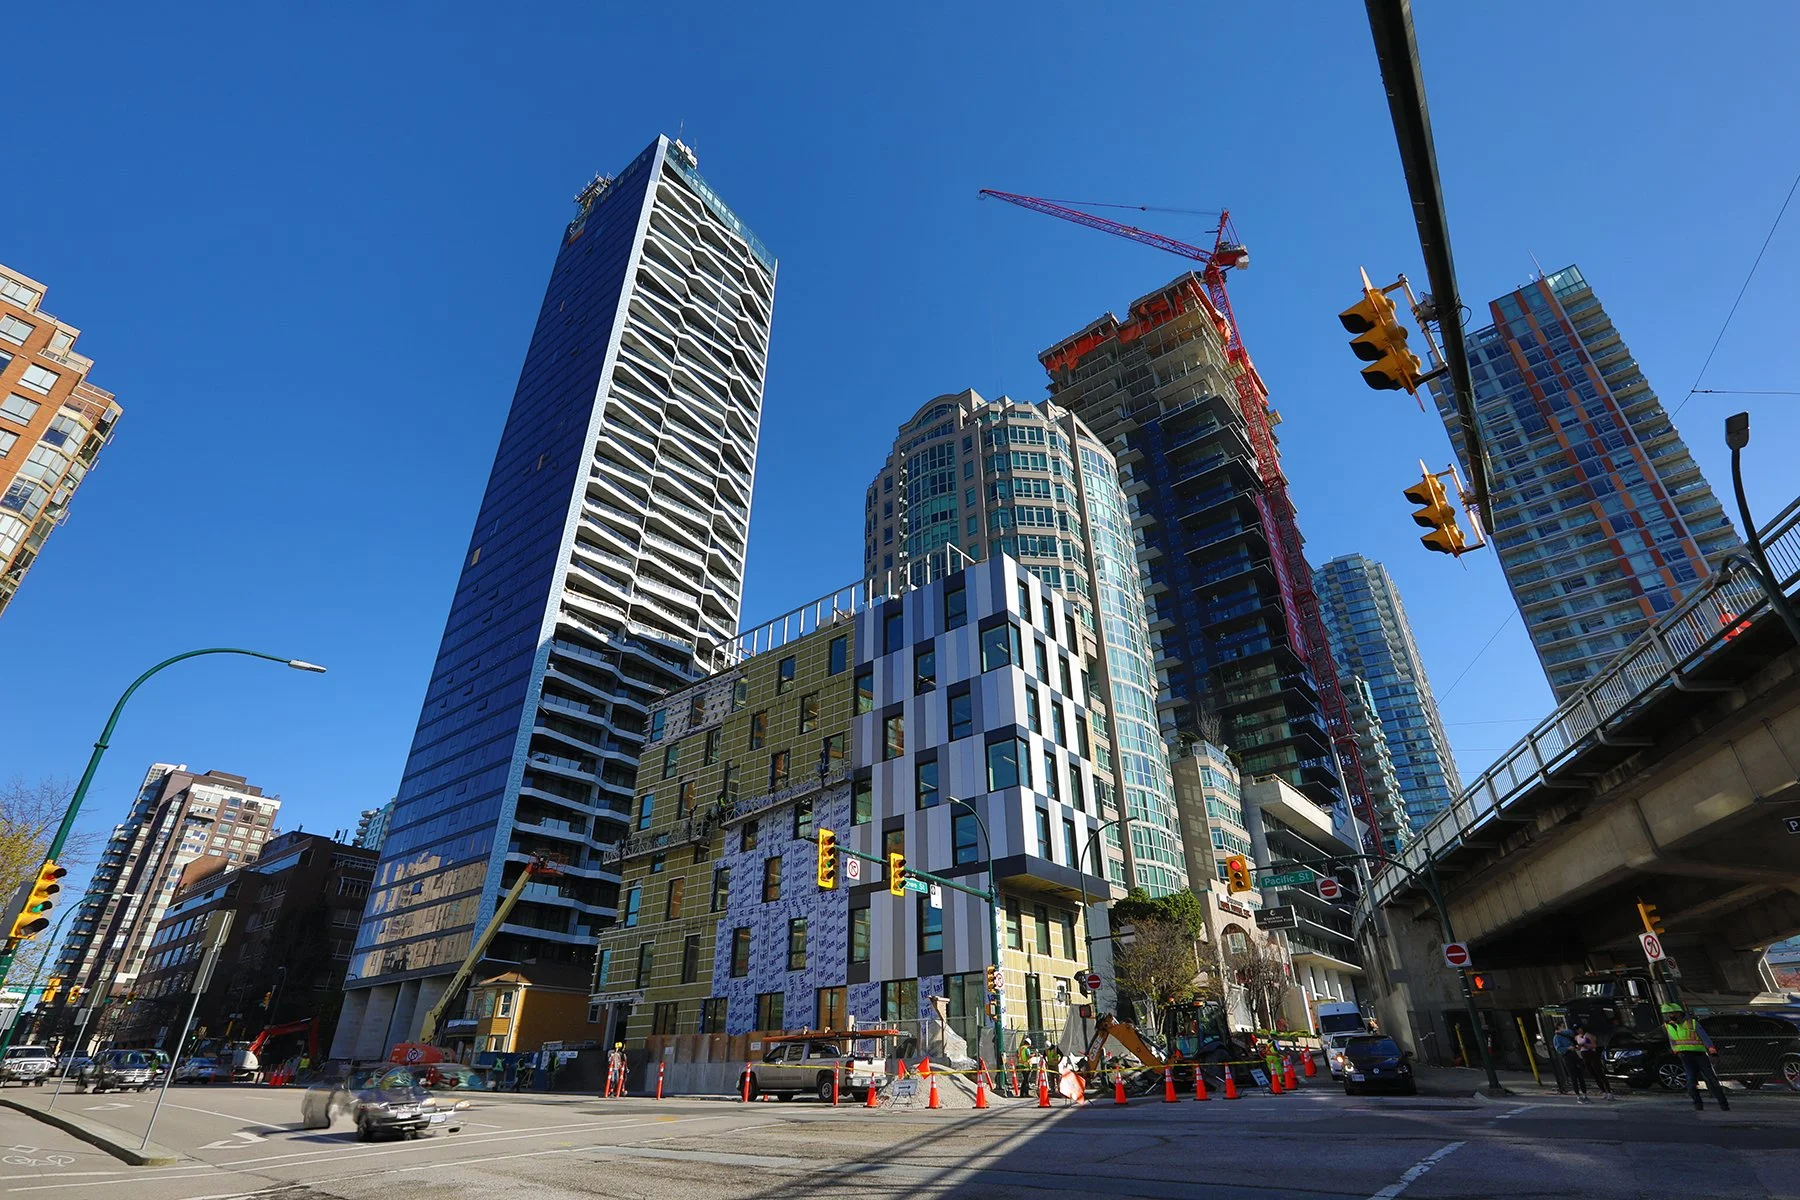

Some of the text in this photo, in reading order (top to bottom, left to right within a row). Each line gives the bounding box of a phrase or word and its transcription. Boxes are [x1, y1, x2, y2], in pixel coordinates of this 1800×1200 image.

[1264, 872, 1309, 886] Pacific St
[796, 990, 813, 1002] larson
[861, 982, 880, 999] larson
[796, 1005, 812, 1018] larson
[861, 999, 880, 1016] larson
